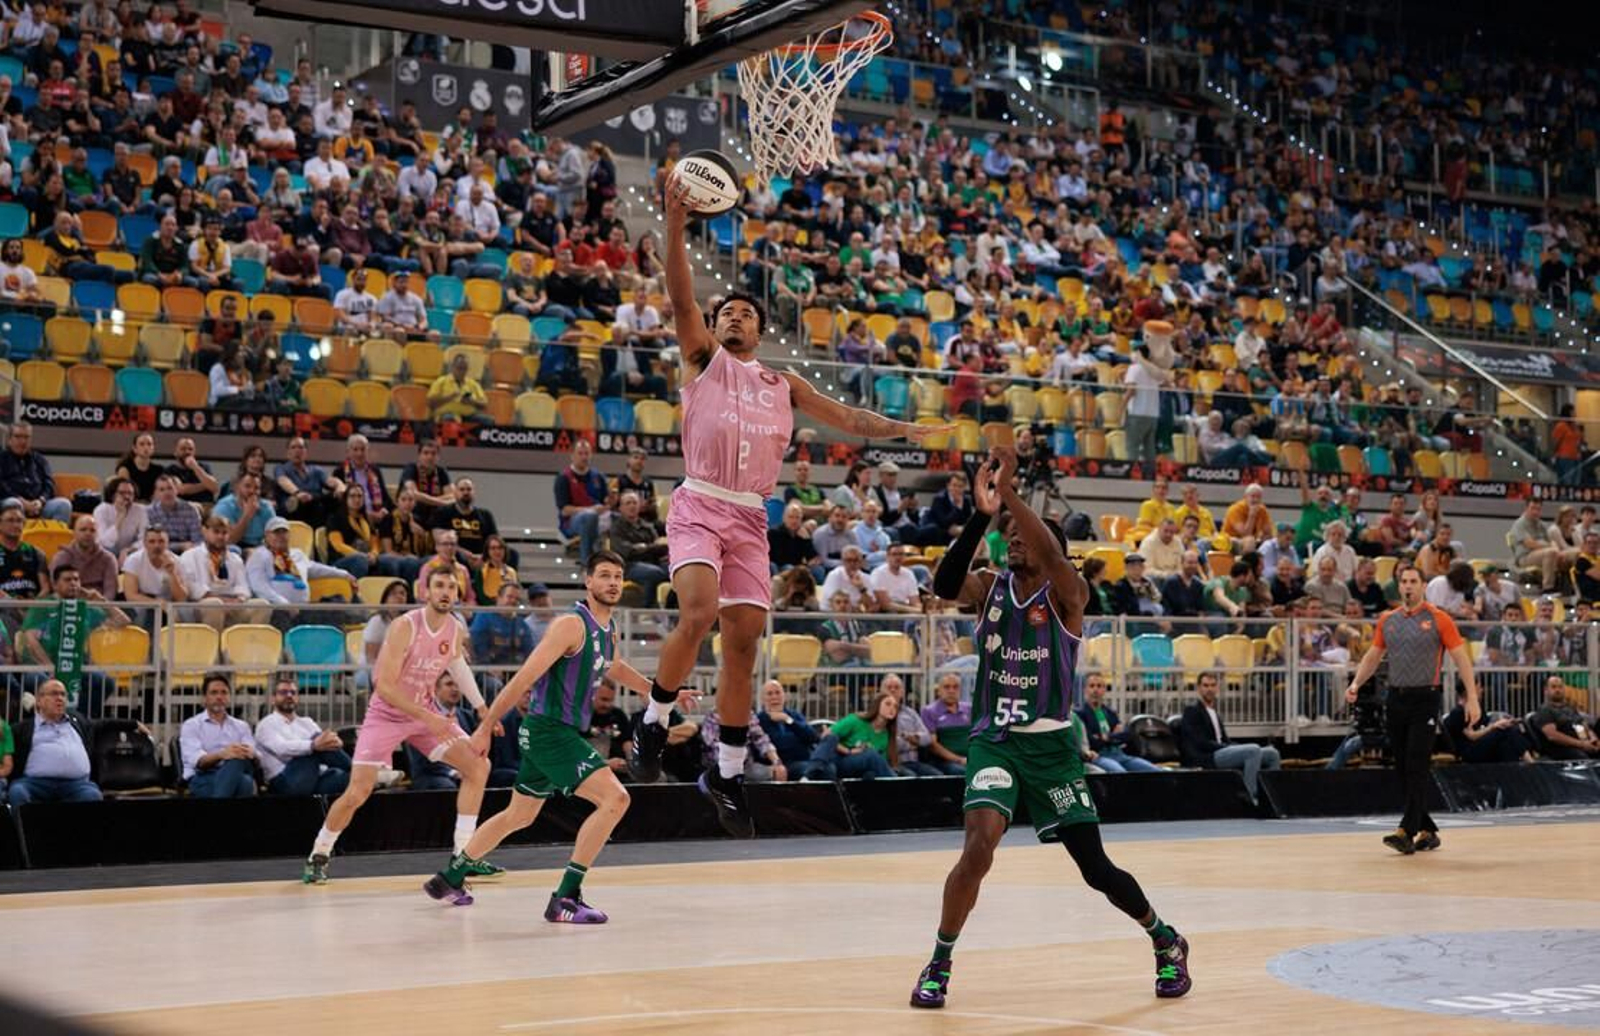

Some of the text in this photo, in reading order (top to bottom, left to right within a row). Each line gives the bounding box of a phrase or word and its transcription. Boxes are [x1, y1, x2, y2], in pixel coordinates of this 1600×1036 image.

[684, 162, 726, 190] Wilson
[479, 429, 554, 445] #CopaACB
[1000, 646, 1050, 663] Unicaja
[993, 696, 1029, 726] 55
